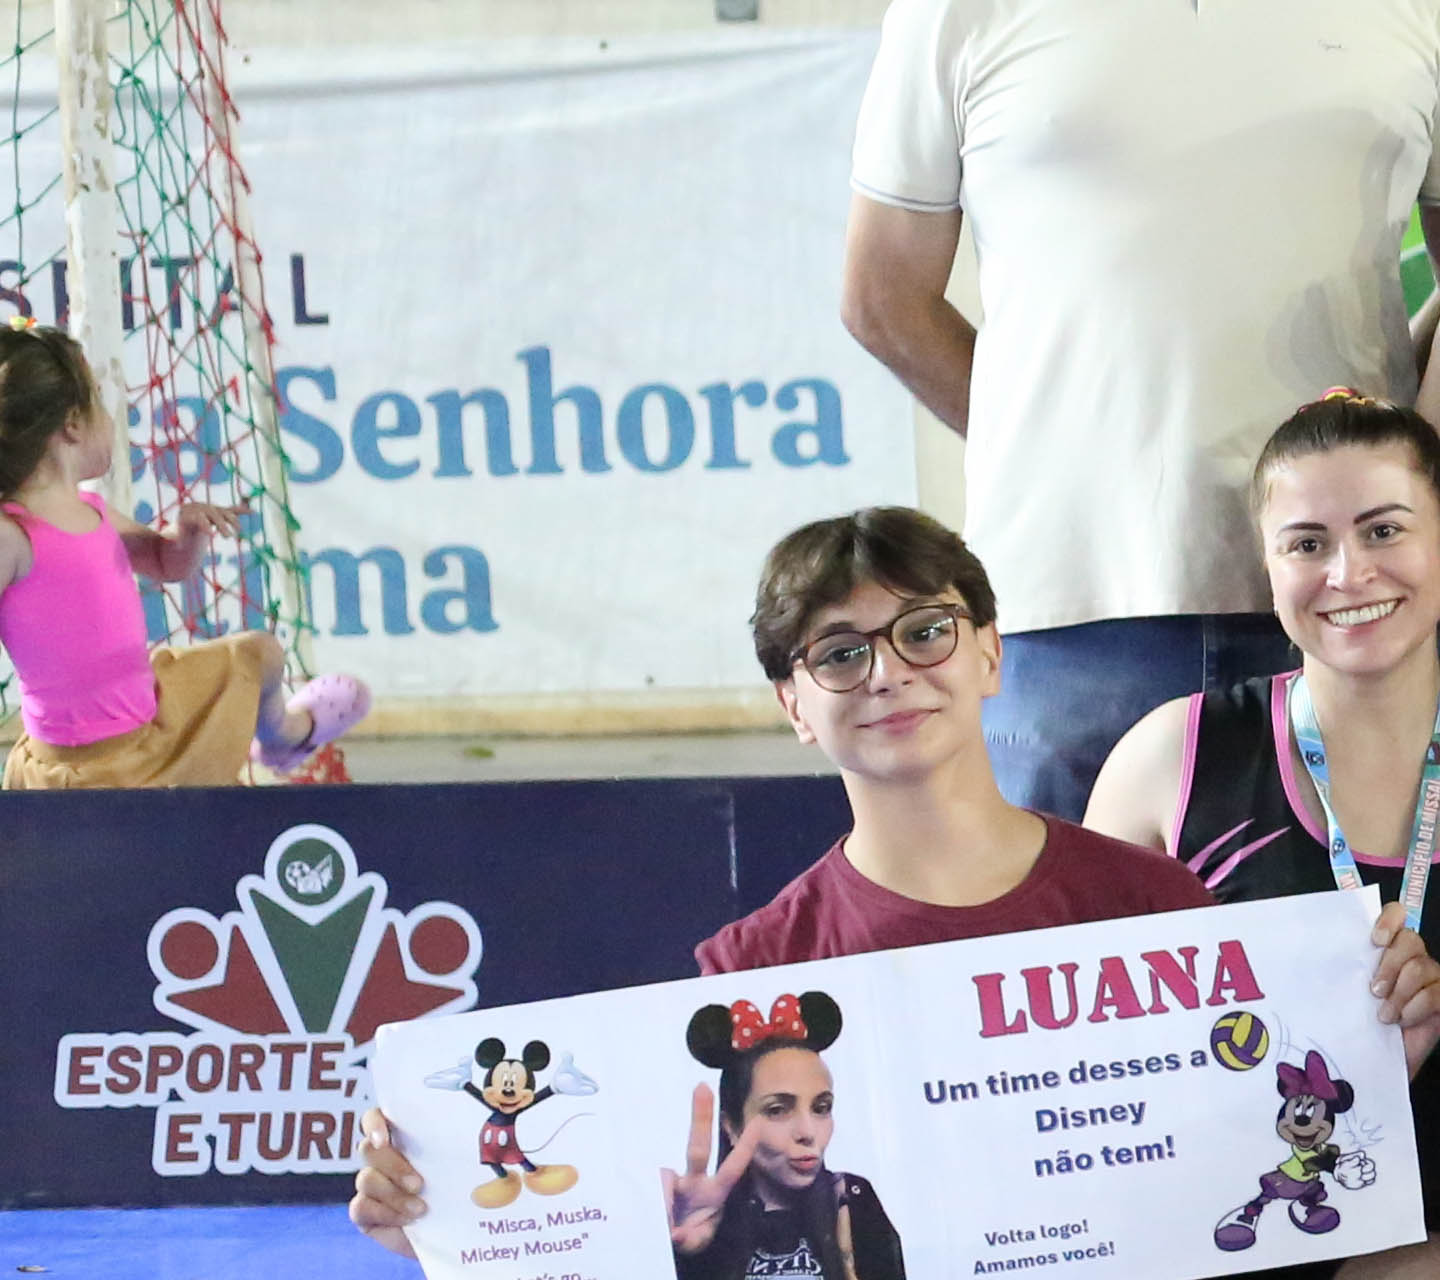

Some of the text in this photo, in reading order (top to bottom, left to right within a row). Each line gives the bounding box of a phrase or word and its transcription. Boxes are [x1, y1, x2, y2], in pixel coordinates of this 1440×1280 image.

[271, 345, 851, 484] Senhora
[971, 940, 1264, 1038] LUANA
[67, 1041, 357, 1098] ESPORTE,
[923, 1049, 1208, 1105] Um time desses a
[164, 1111, 360, 1163] E TURI
[1034, 1099, 1147, 1133] Disney
[1033, 1135, 1176, 1177] não tem!
[546, 1206, 608, 1228] Muska,
[984, 1220, 1090, 1247] Volta logo!
[460, 1245, 520, 1266] Mickey
[973, 1240, 1116, 1275] Amamos você!
